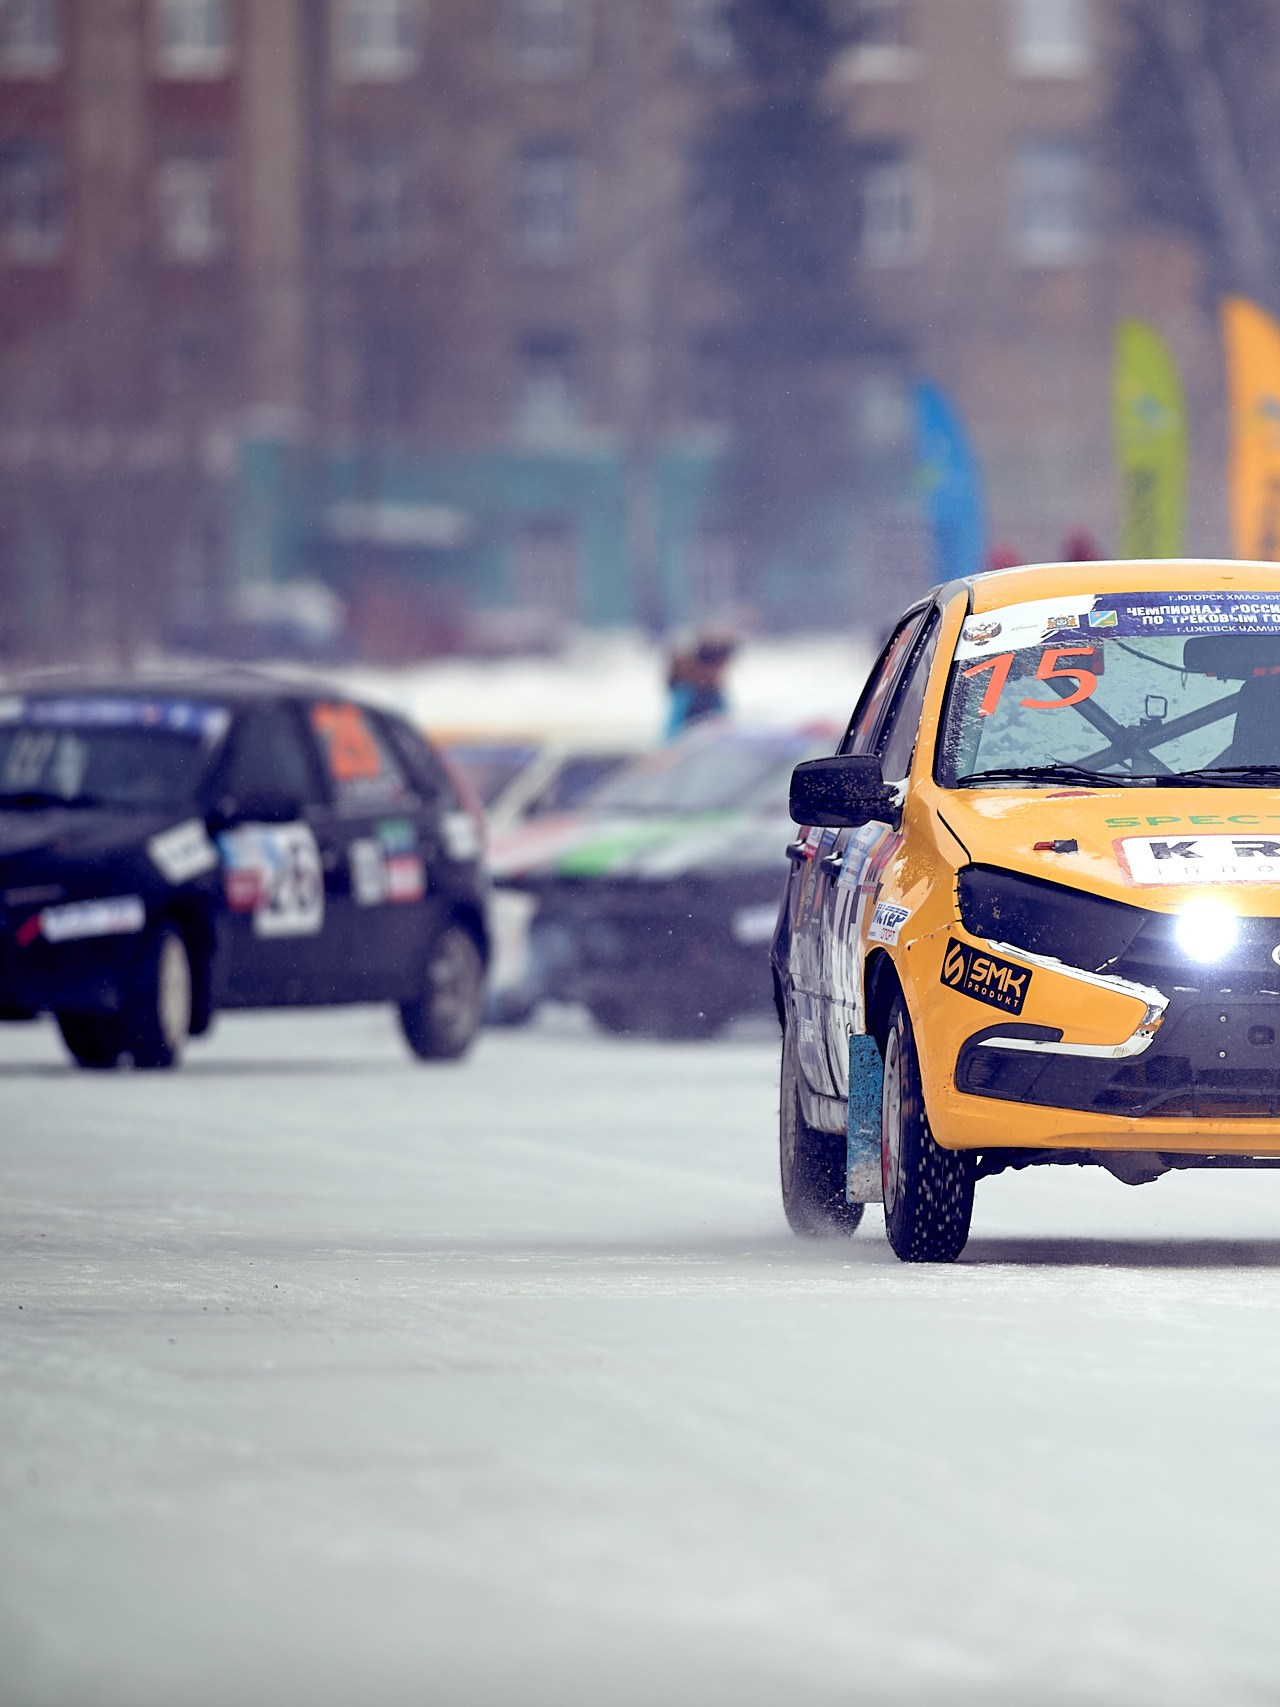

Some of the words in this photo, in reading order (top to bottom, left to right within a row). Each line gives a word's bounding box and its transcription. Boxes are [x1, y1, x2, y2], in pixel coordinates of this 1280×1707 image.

[1126, 604, 1222, 616] ЧЕМПИОНАТ
[1142, 615, 1164, 625] ПО
[1169, 614, 1258, 624] ТРЕКОВЫМ
[962, 645, 1098, 717] 15
[970, 957, 1027, 998] SMK
[967, 981, 1020, 1008] PRODUKT
